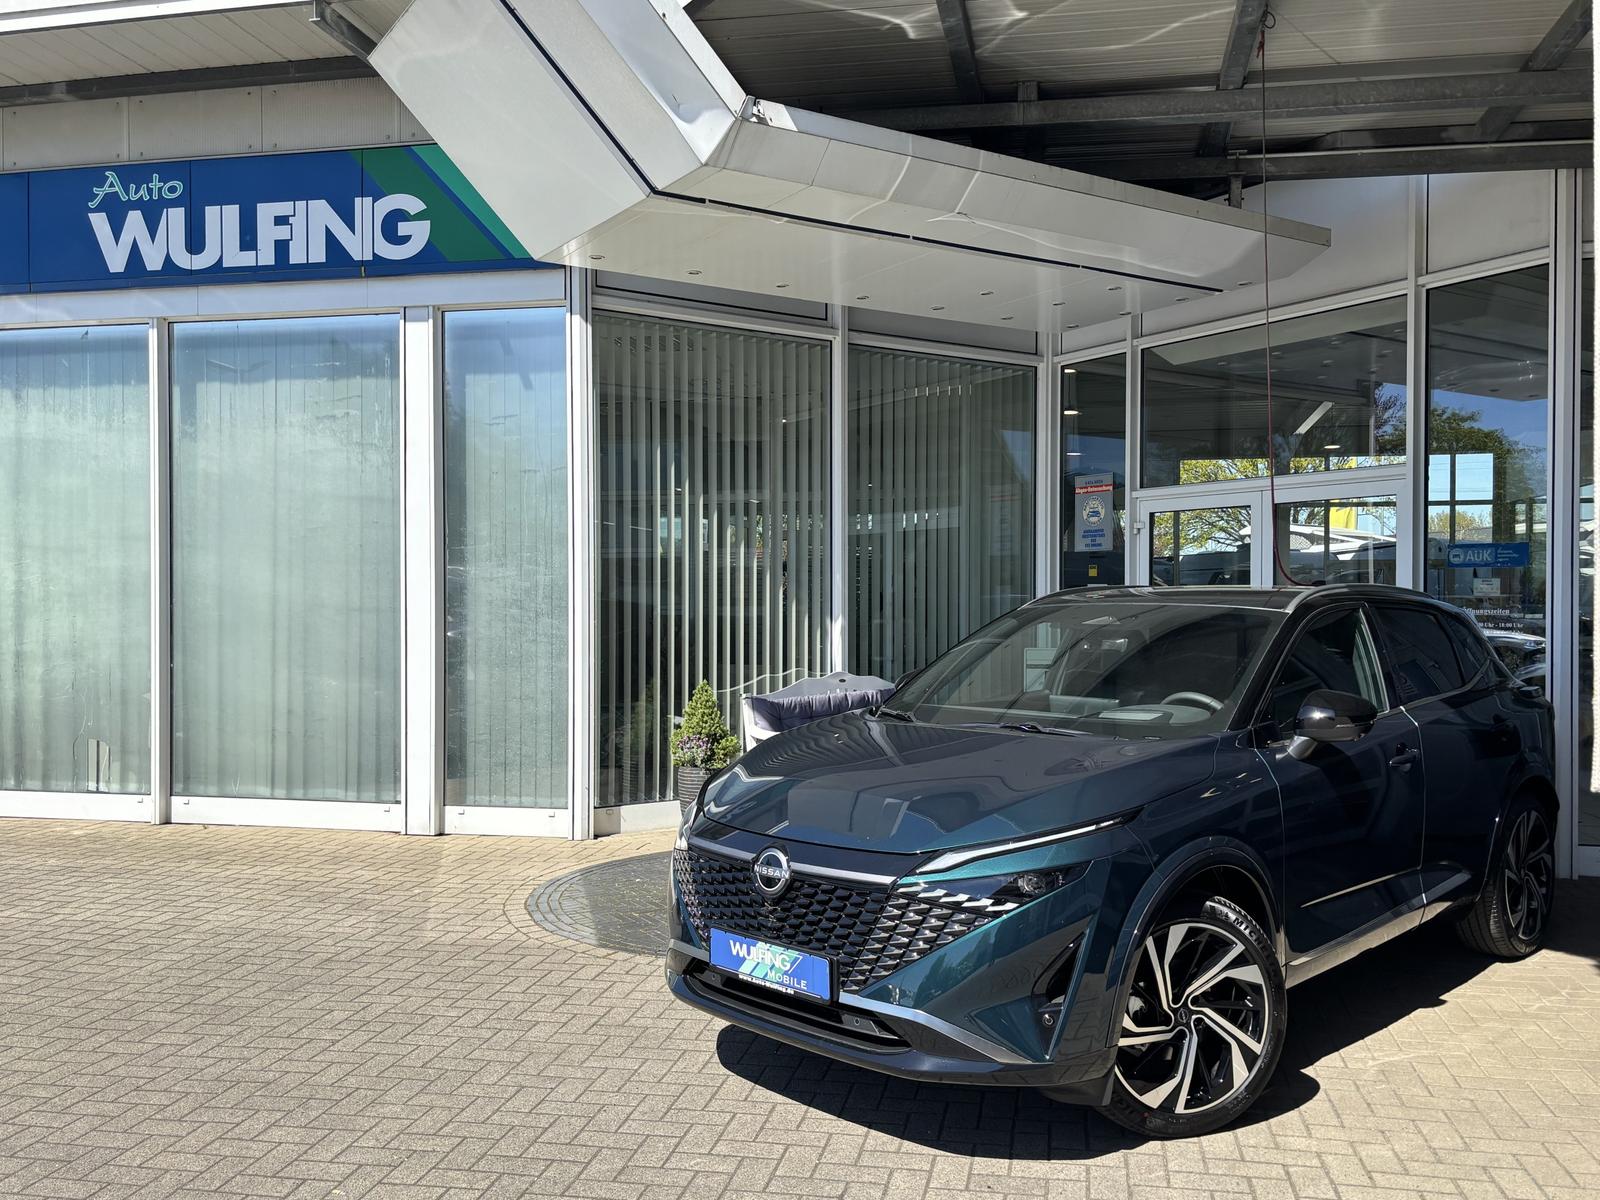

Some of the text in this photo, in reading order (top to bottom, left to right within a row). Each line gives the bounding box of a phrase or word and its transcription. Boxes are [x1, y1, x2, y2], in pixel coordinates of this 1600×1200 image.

[88, 171, 184, 208] Auto
[87, 193, 432, 274] WULFING
[753, 864, 790, 880] NISSAN
[729, 939, 791, 972] WULFING
[767, 969, 808, 990] MOBILE
